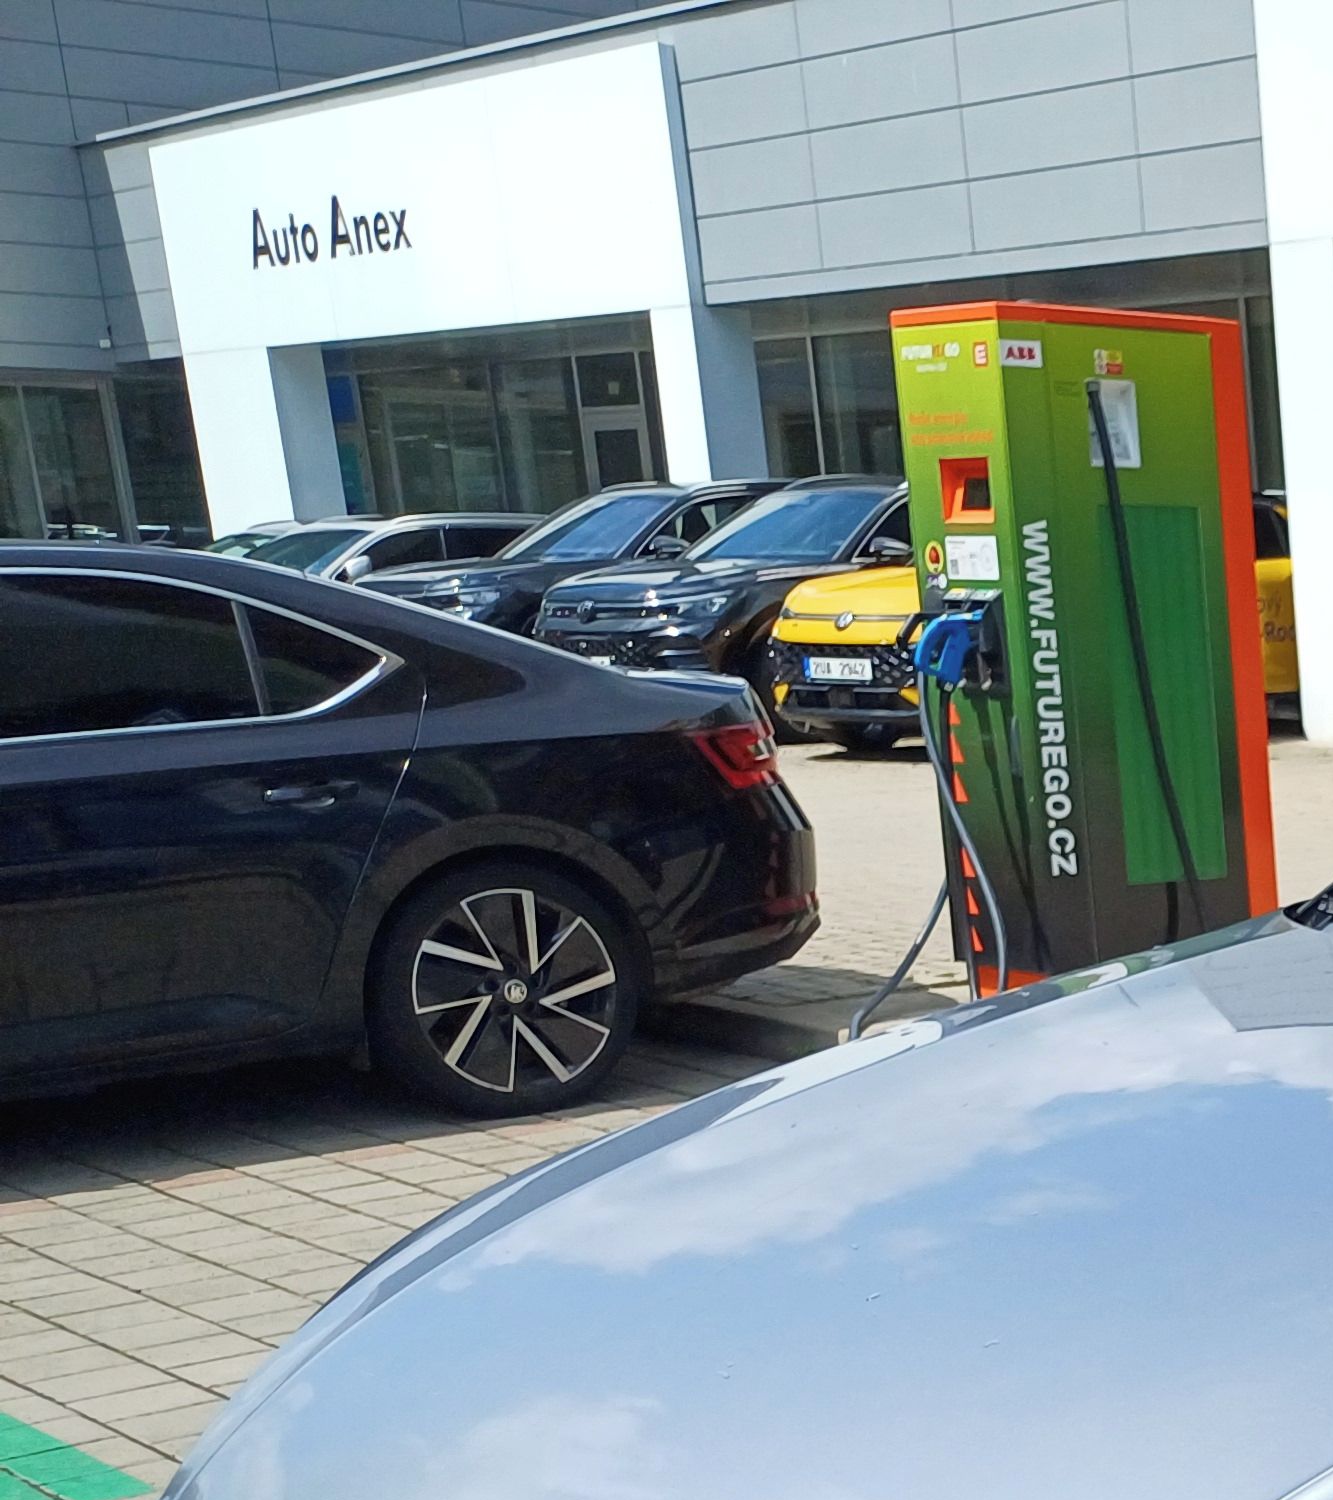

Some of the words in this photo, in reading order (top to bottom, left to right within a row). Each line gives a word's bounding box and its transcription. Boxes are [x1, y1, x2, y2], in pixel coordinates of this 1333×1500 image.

[252, 208, 319, 270] Auto
[330, 195, 413, 259] Anex
[1004, 346, 1036, 361] ABB
[1021, 519, 1079, 878] WWW.FUTUREGO.CZ
